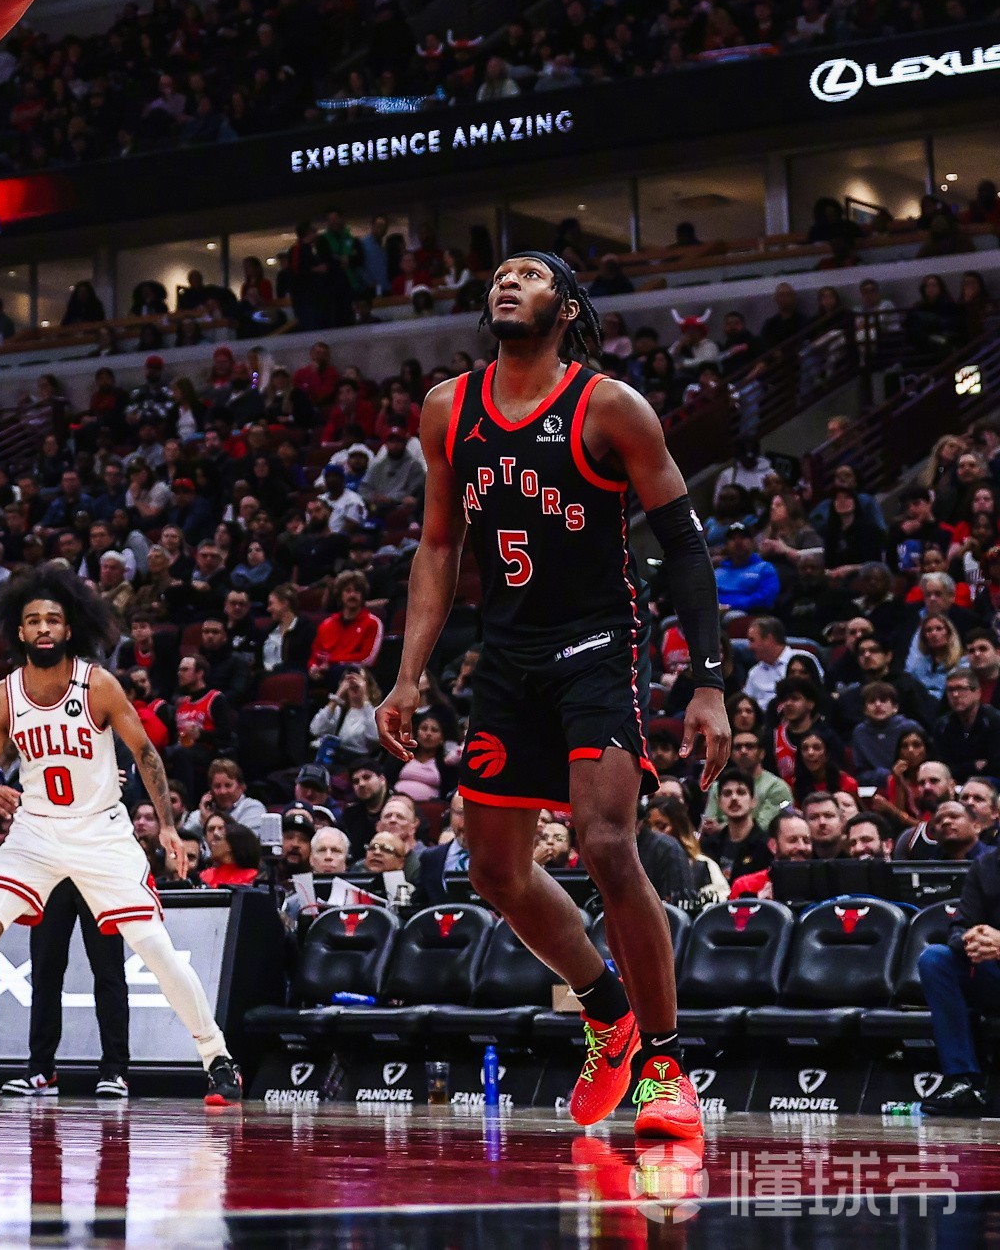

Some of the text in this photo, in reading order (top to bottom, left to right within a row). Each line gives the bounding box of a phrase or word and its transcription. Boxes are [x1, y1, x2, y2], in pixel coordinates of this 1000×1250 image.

[291, 110, 574, 173] EXPERIENCE AMAZING
[536, 434, 566, 443] Sun Life
[497, 529, 534, 587] 5
[43, 765, 75, 807] 0
[264, 1089, 320, 1102] FANDUEL
[356, 1088, 414, 1101] FANDUEL
[769, 1096, 839, 1111] FANDUEL
